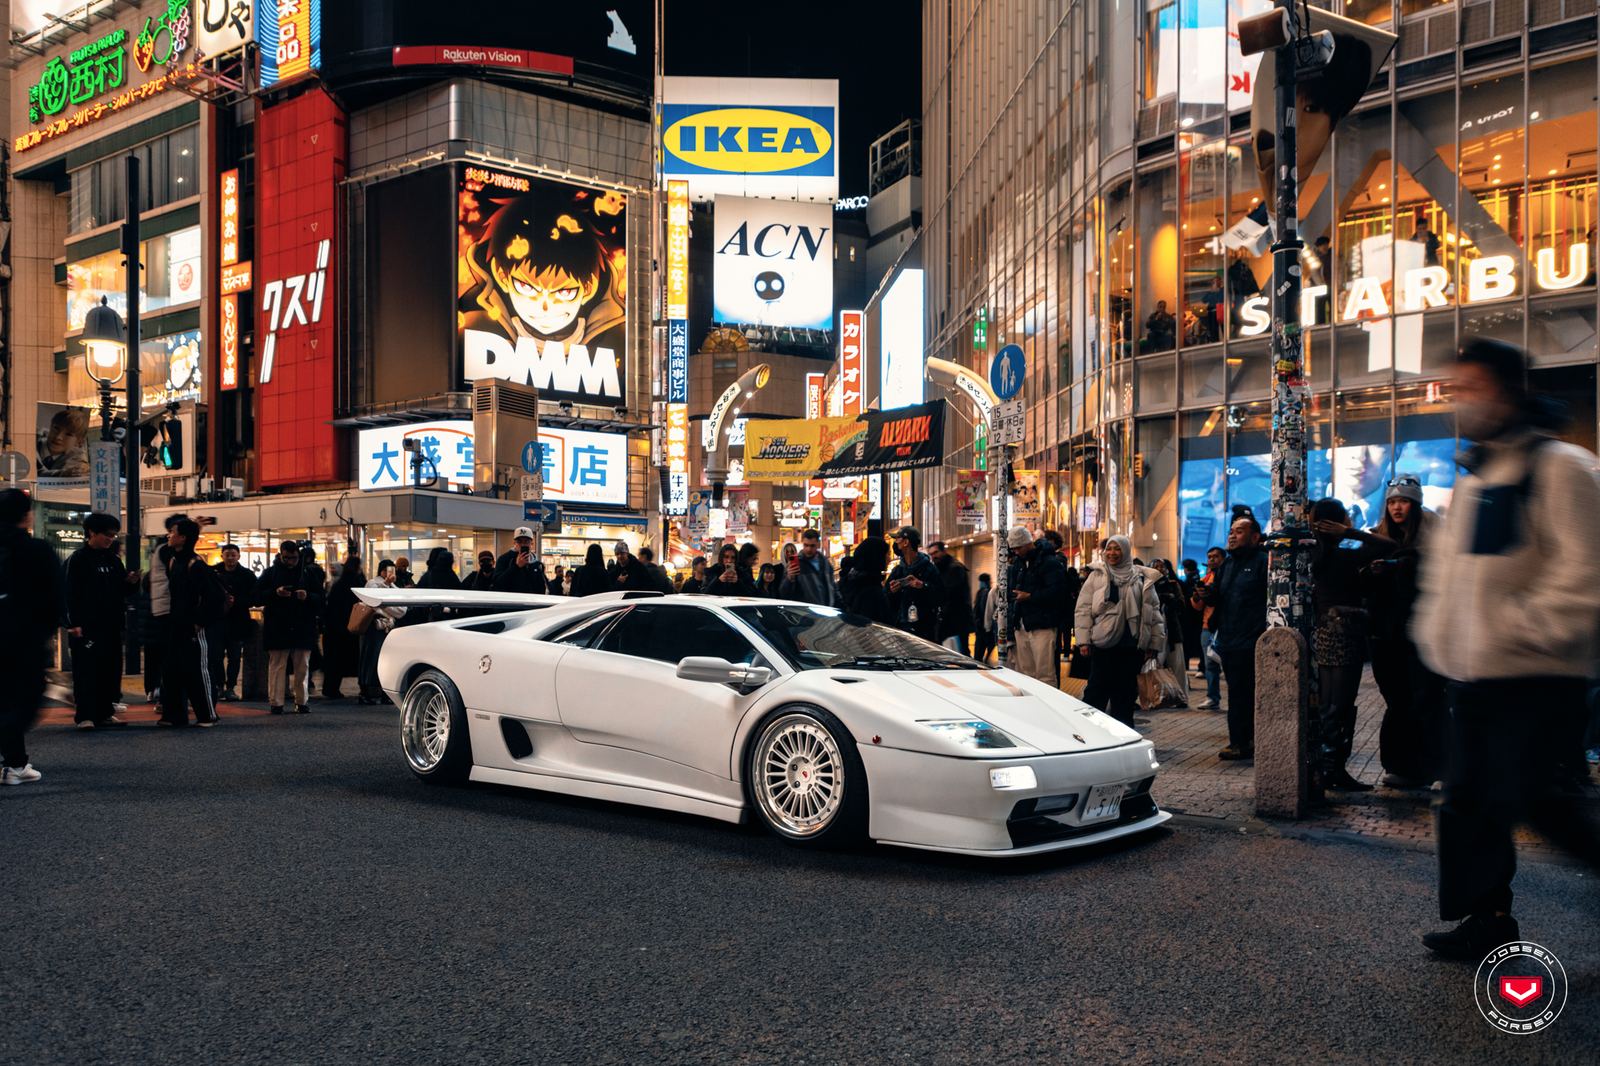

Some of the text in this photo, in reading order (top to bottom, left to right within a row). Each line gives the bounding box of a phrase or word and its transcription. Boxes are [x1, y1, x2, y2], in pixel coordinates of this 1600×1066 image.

[69, 45, 126, 105] 西村
[442, 49, 522, 64] Rakuten Vision
[679, 125, 820, 154] IKEA
[835, 195, 870, 211] PARCO
[715, 220, 830, 262] ACN
[260, 238, 331, 384] クスリ
[464, 329, 622, 398] DMM
[671, 323, 686, 401] 大盛堂商事ビル
[842, 322, 860, 405] カラオケ
[752, 436, 811, 460] ROCKERS
[879, 415, 932, 448] ALVARK
